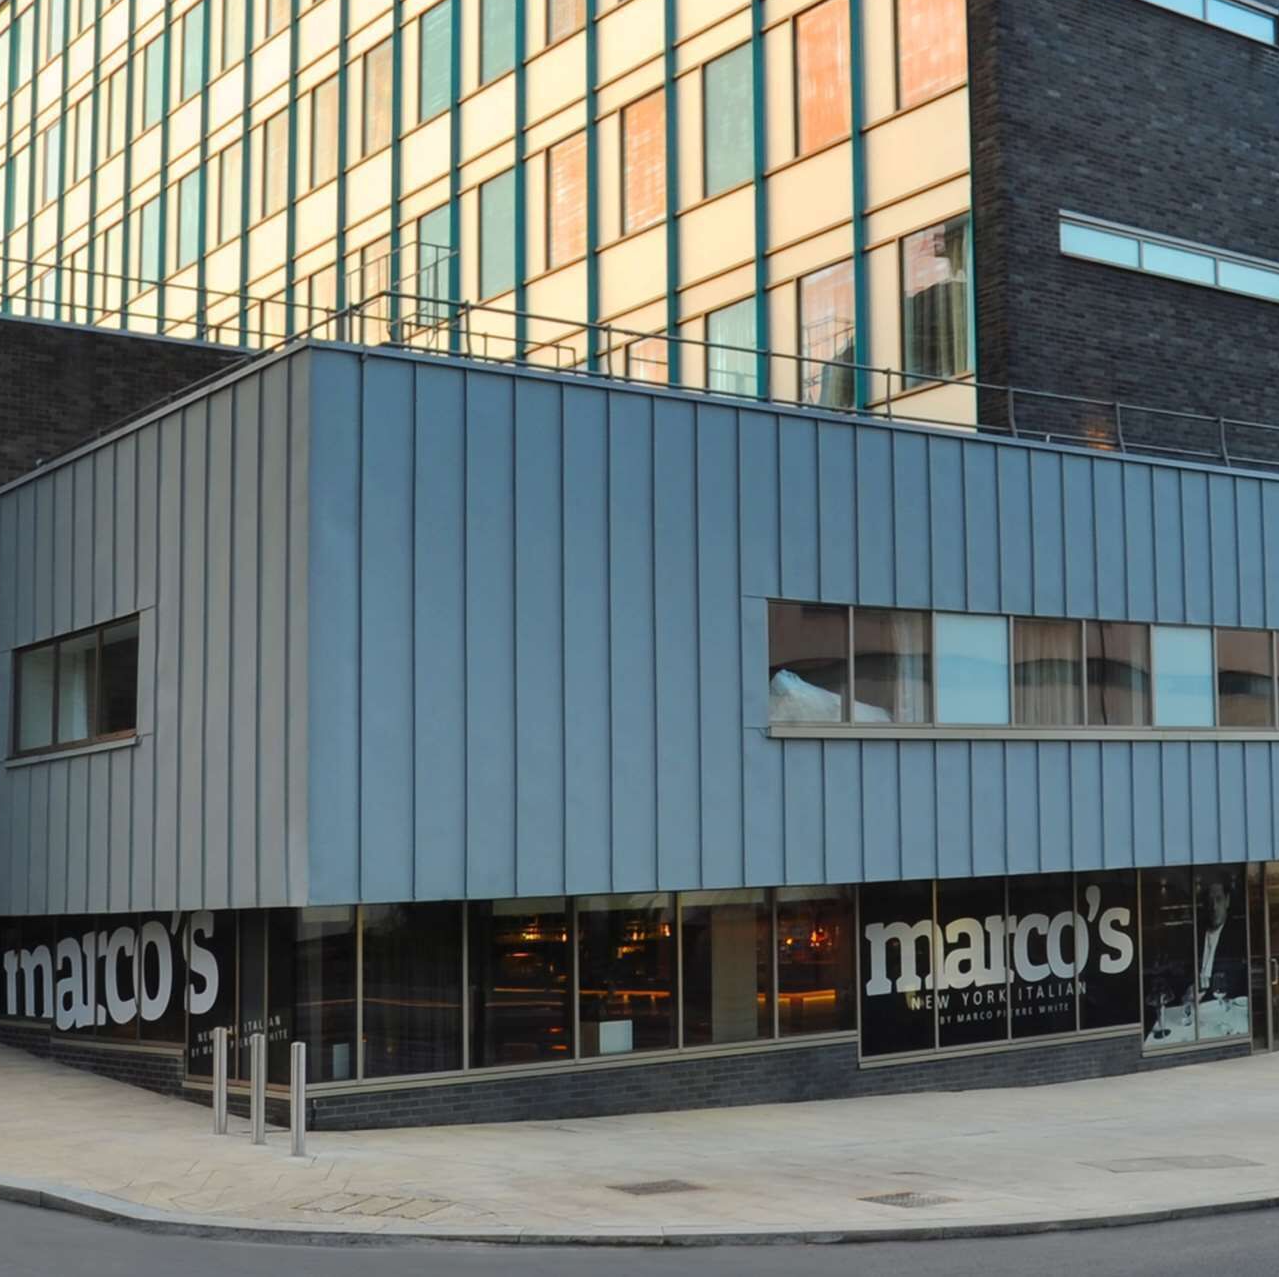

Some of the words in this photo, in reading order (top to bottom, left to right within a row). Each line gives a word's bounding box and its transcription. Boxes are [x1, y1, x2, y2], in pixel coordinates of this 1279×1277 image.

[864, 884, 1134, 996] marco's
[3, 910, 219, 1031] marco's
[911, 995, 950, 1010] NEW
[962, 989, 1008, 1006] YORK
[1018, 981, 1087, 1001] ITALIAN
[243, 1015, 280, 1033] ITALAN
[940, 1015, 952, 1024] BY
[957, 1010, 993, 1022] MARCO
[996, 1007, 1033, 1018] PIRRE
[1038, 1003, 1069, 1014] WHITE
